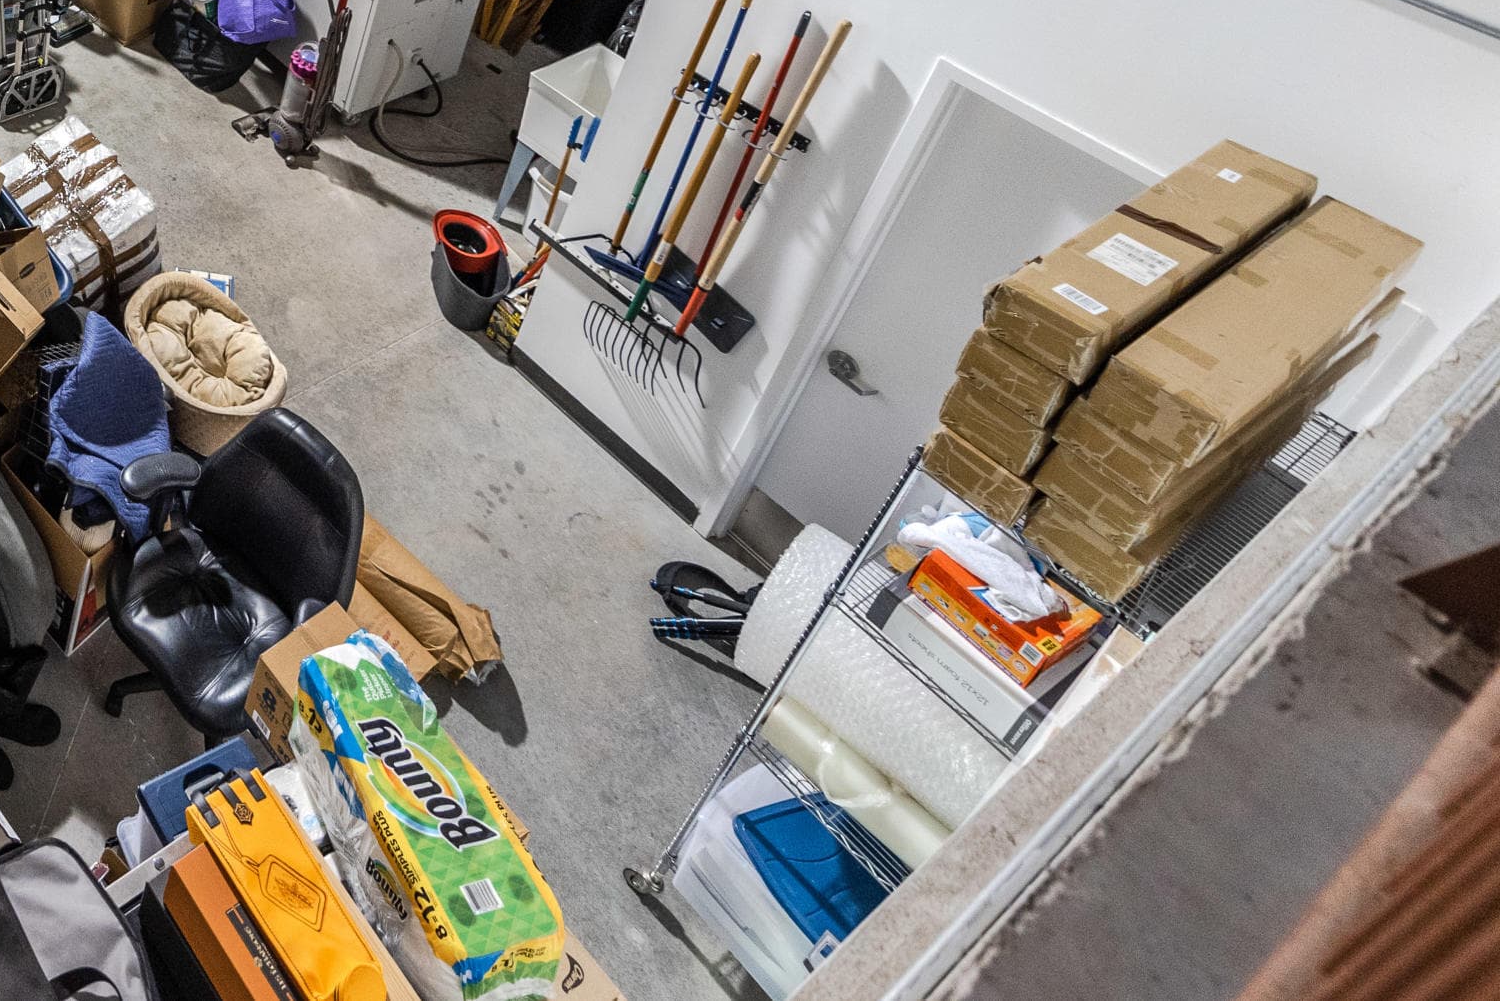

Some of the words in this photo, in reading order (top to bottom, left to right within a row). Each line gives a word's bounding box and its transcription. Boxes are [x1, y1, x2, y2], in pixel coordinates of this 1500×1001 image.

[907, 632, 934, 659] sheets
[936, 657, 960, 681] foam
[961, 680, 989, 706] 12x12
[357, 717, 500, 851] Bounty
[376, 810, 394, 837] PLUS
[390, 838, 418, 886] SIMPLES
[365, 856, 408, 920] Bounty
[414, 886, 436, 924] 12
[435, 924, 448, 940] 8
